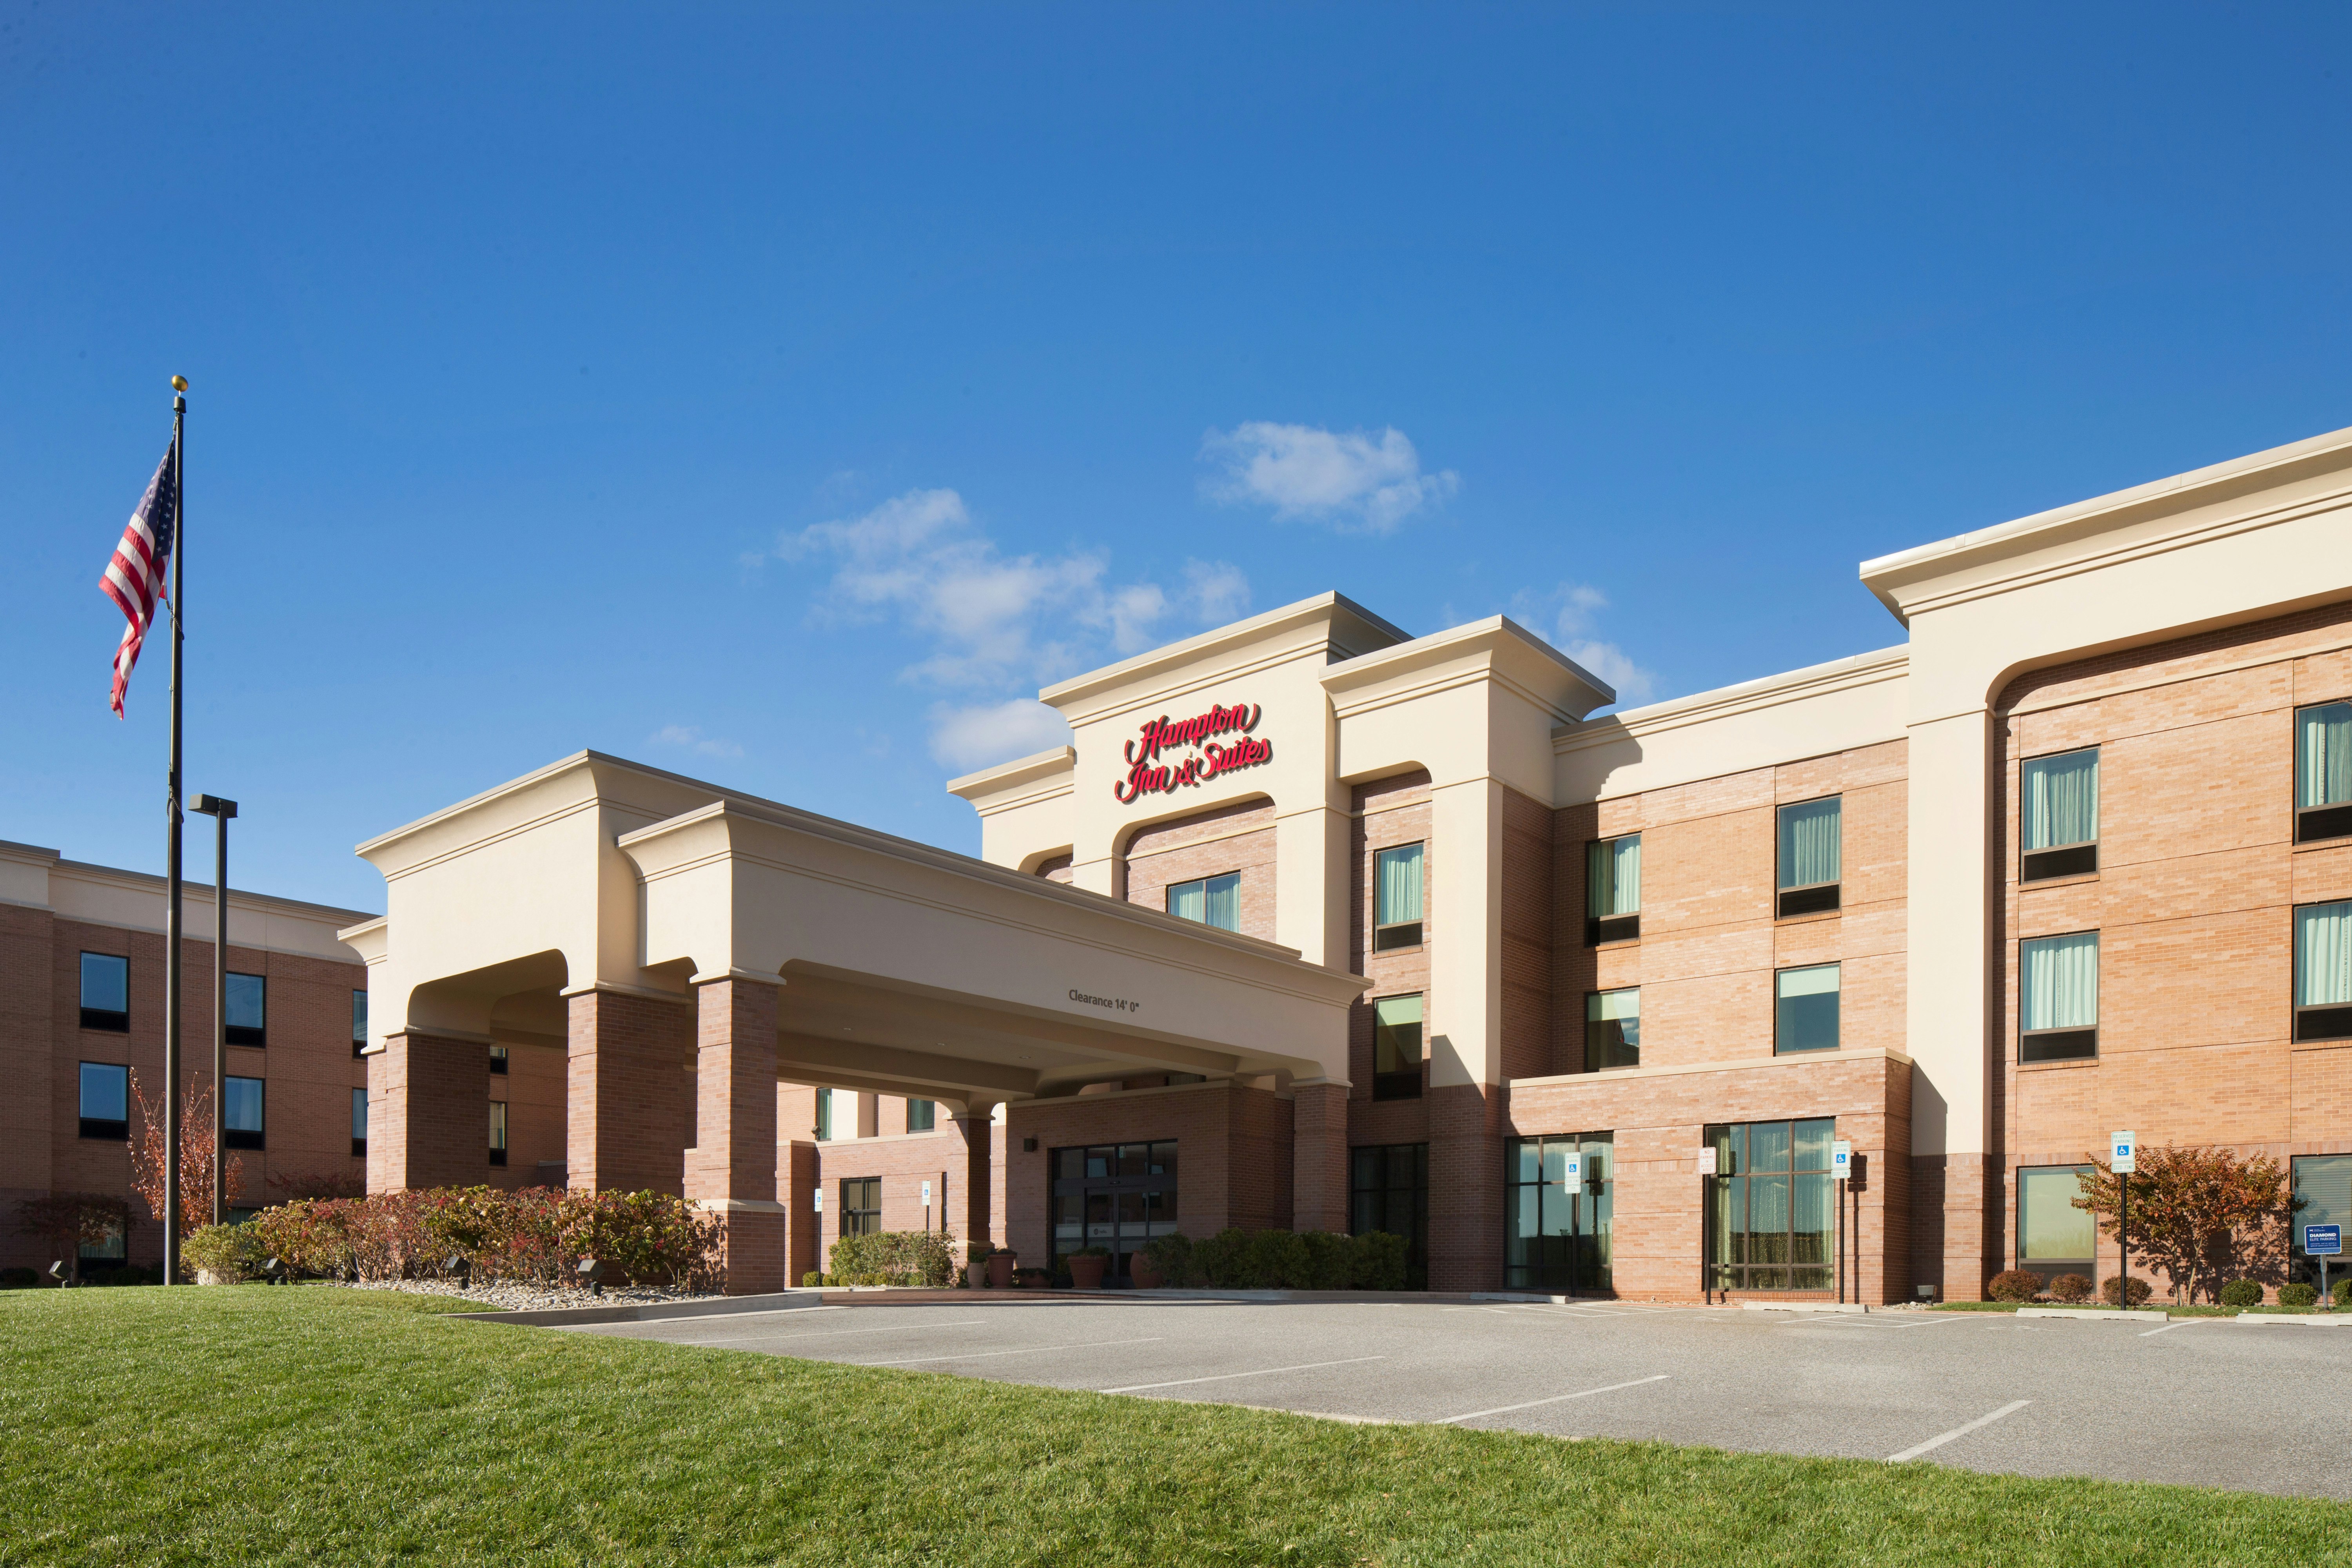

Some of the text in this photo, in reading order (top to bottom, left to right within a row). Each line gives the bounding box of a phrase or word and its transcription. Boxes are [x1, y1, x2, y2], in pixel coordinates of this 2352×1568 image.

[1124, 703, 1261, 765] Hampton
[1114, 736, 1271, 802] Inn & Suites
[1069, 989, 1113, 1008] Clearance
[1115, 998, 1127, 1010] 14'
